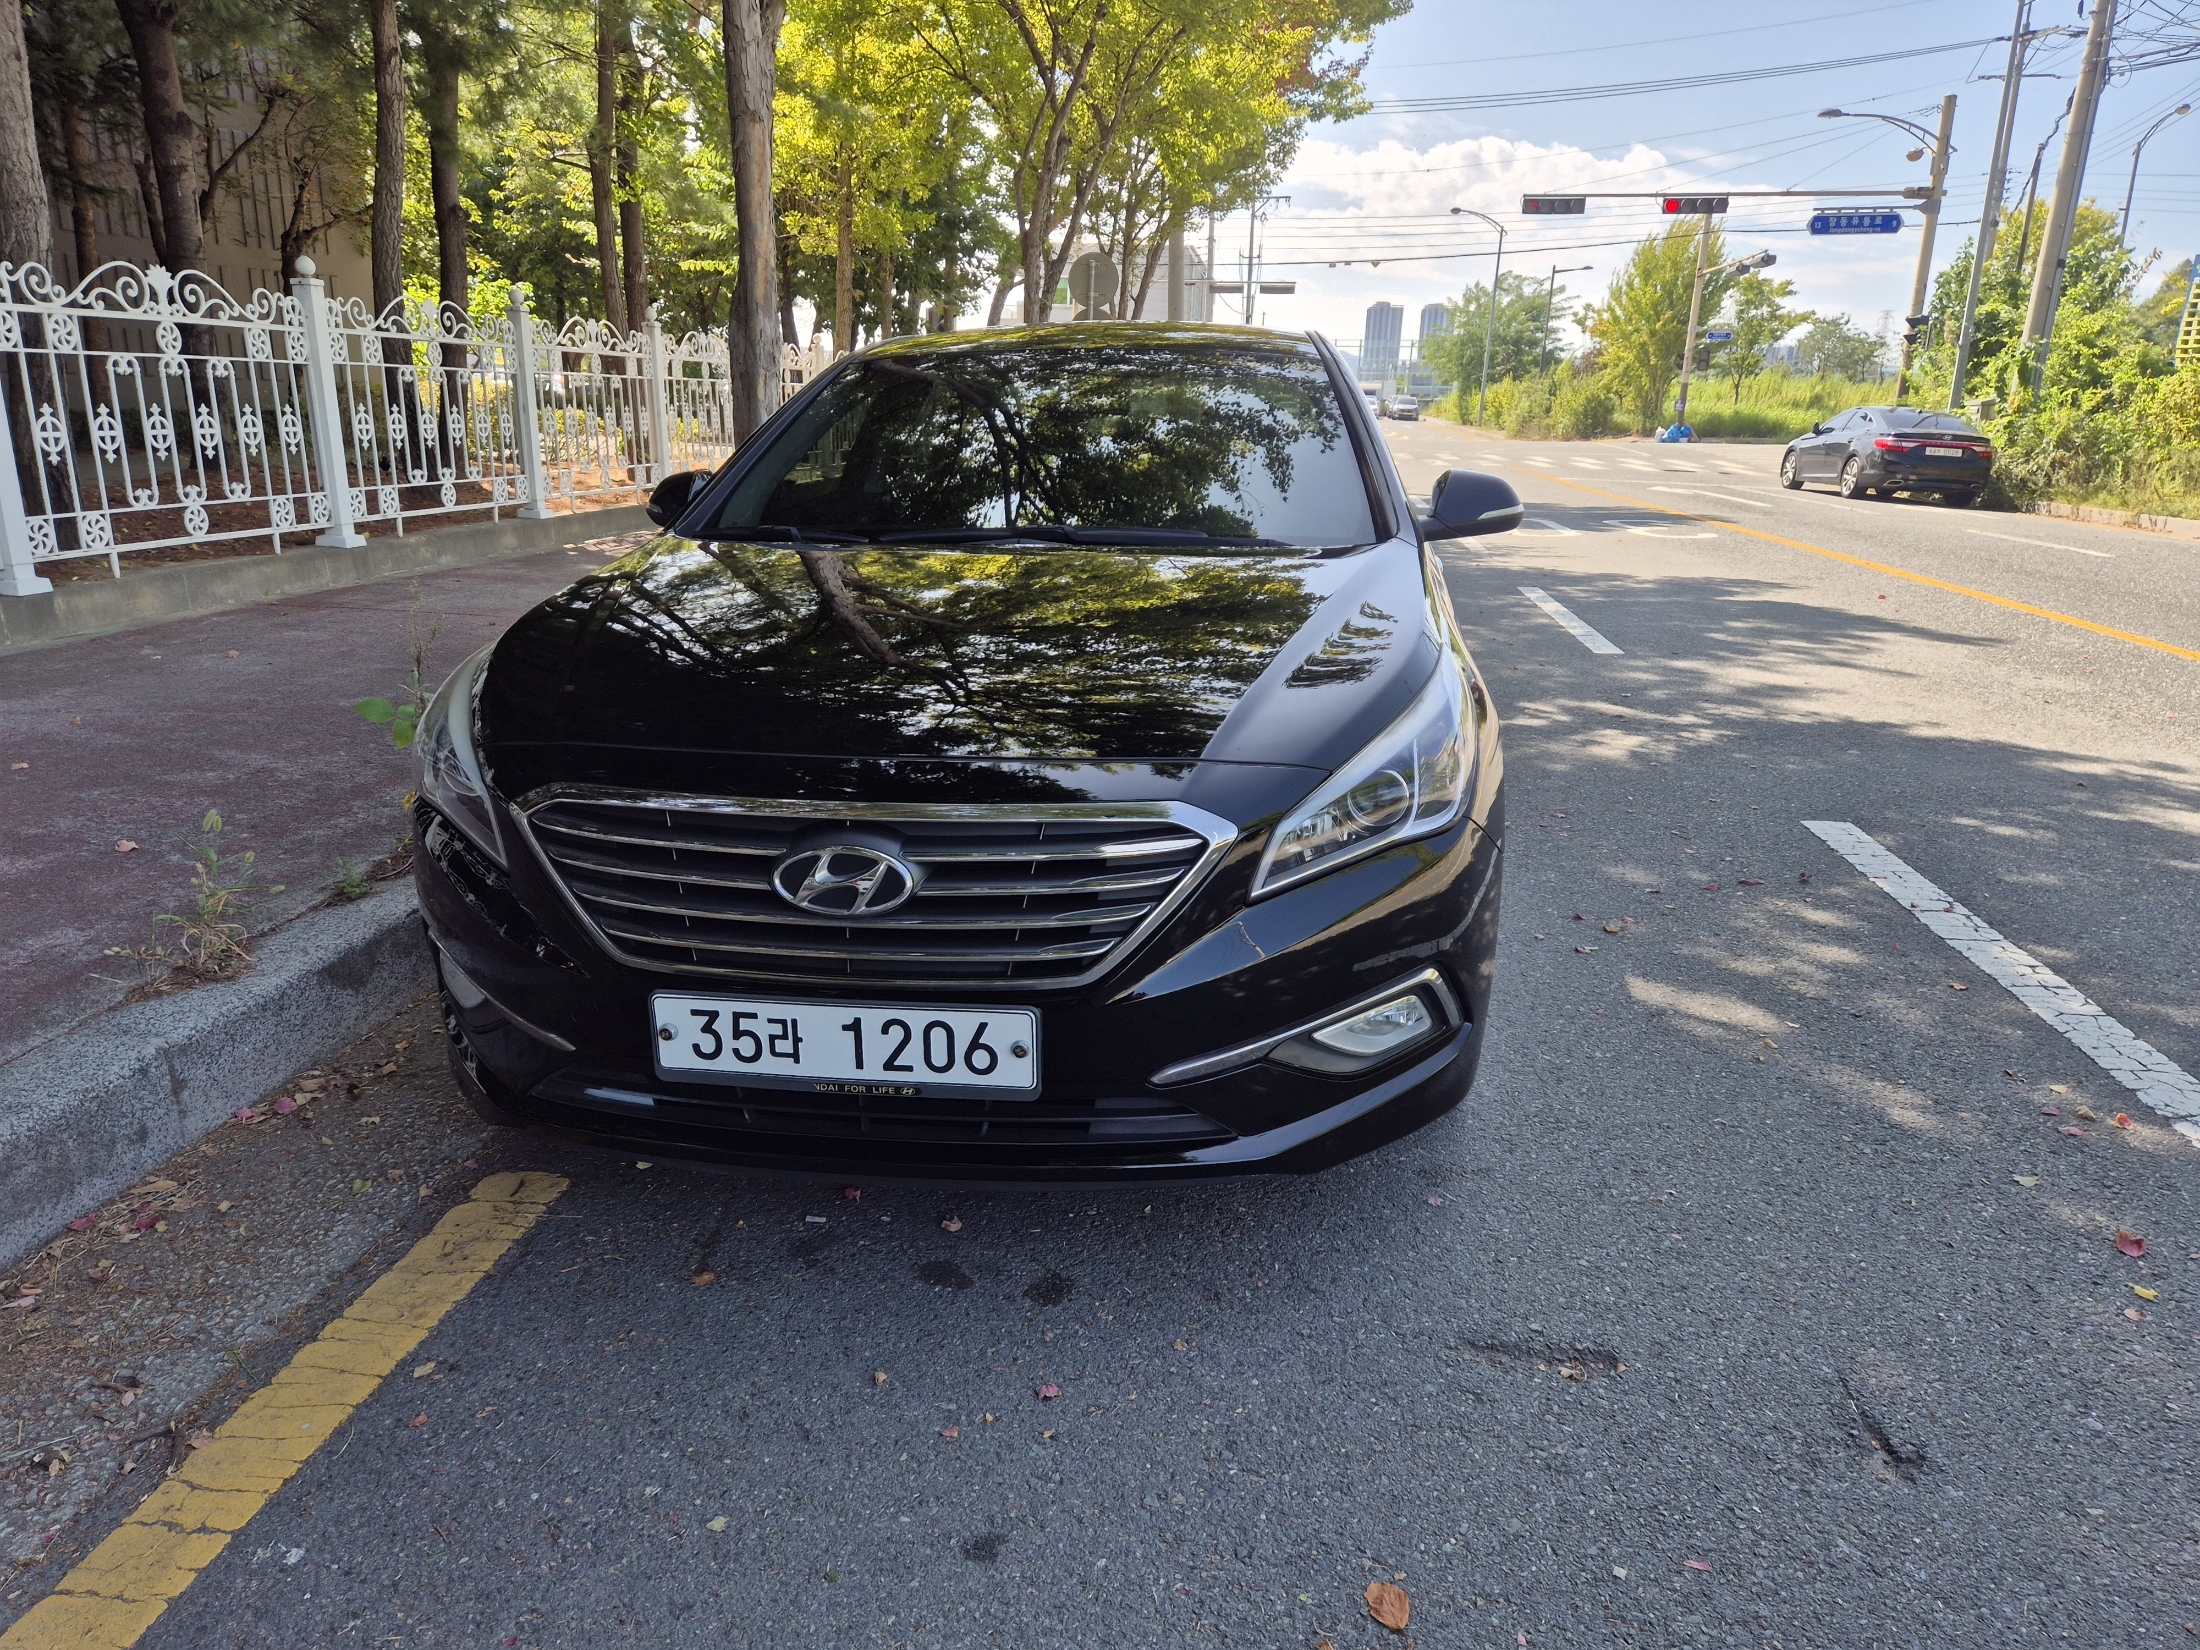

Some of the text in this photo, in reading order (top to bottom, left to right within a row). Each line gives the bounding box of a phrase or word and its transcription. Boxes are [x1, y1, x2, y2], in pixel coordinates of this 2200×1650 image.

[690, 1008, 999, 1076] 35라 1206
[844, 1084, 866, 1093] FOR
[872, 1086, 896, 1095] LIFE
